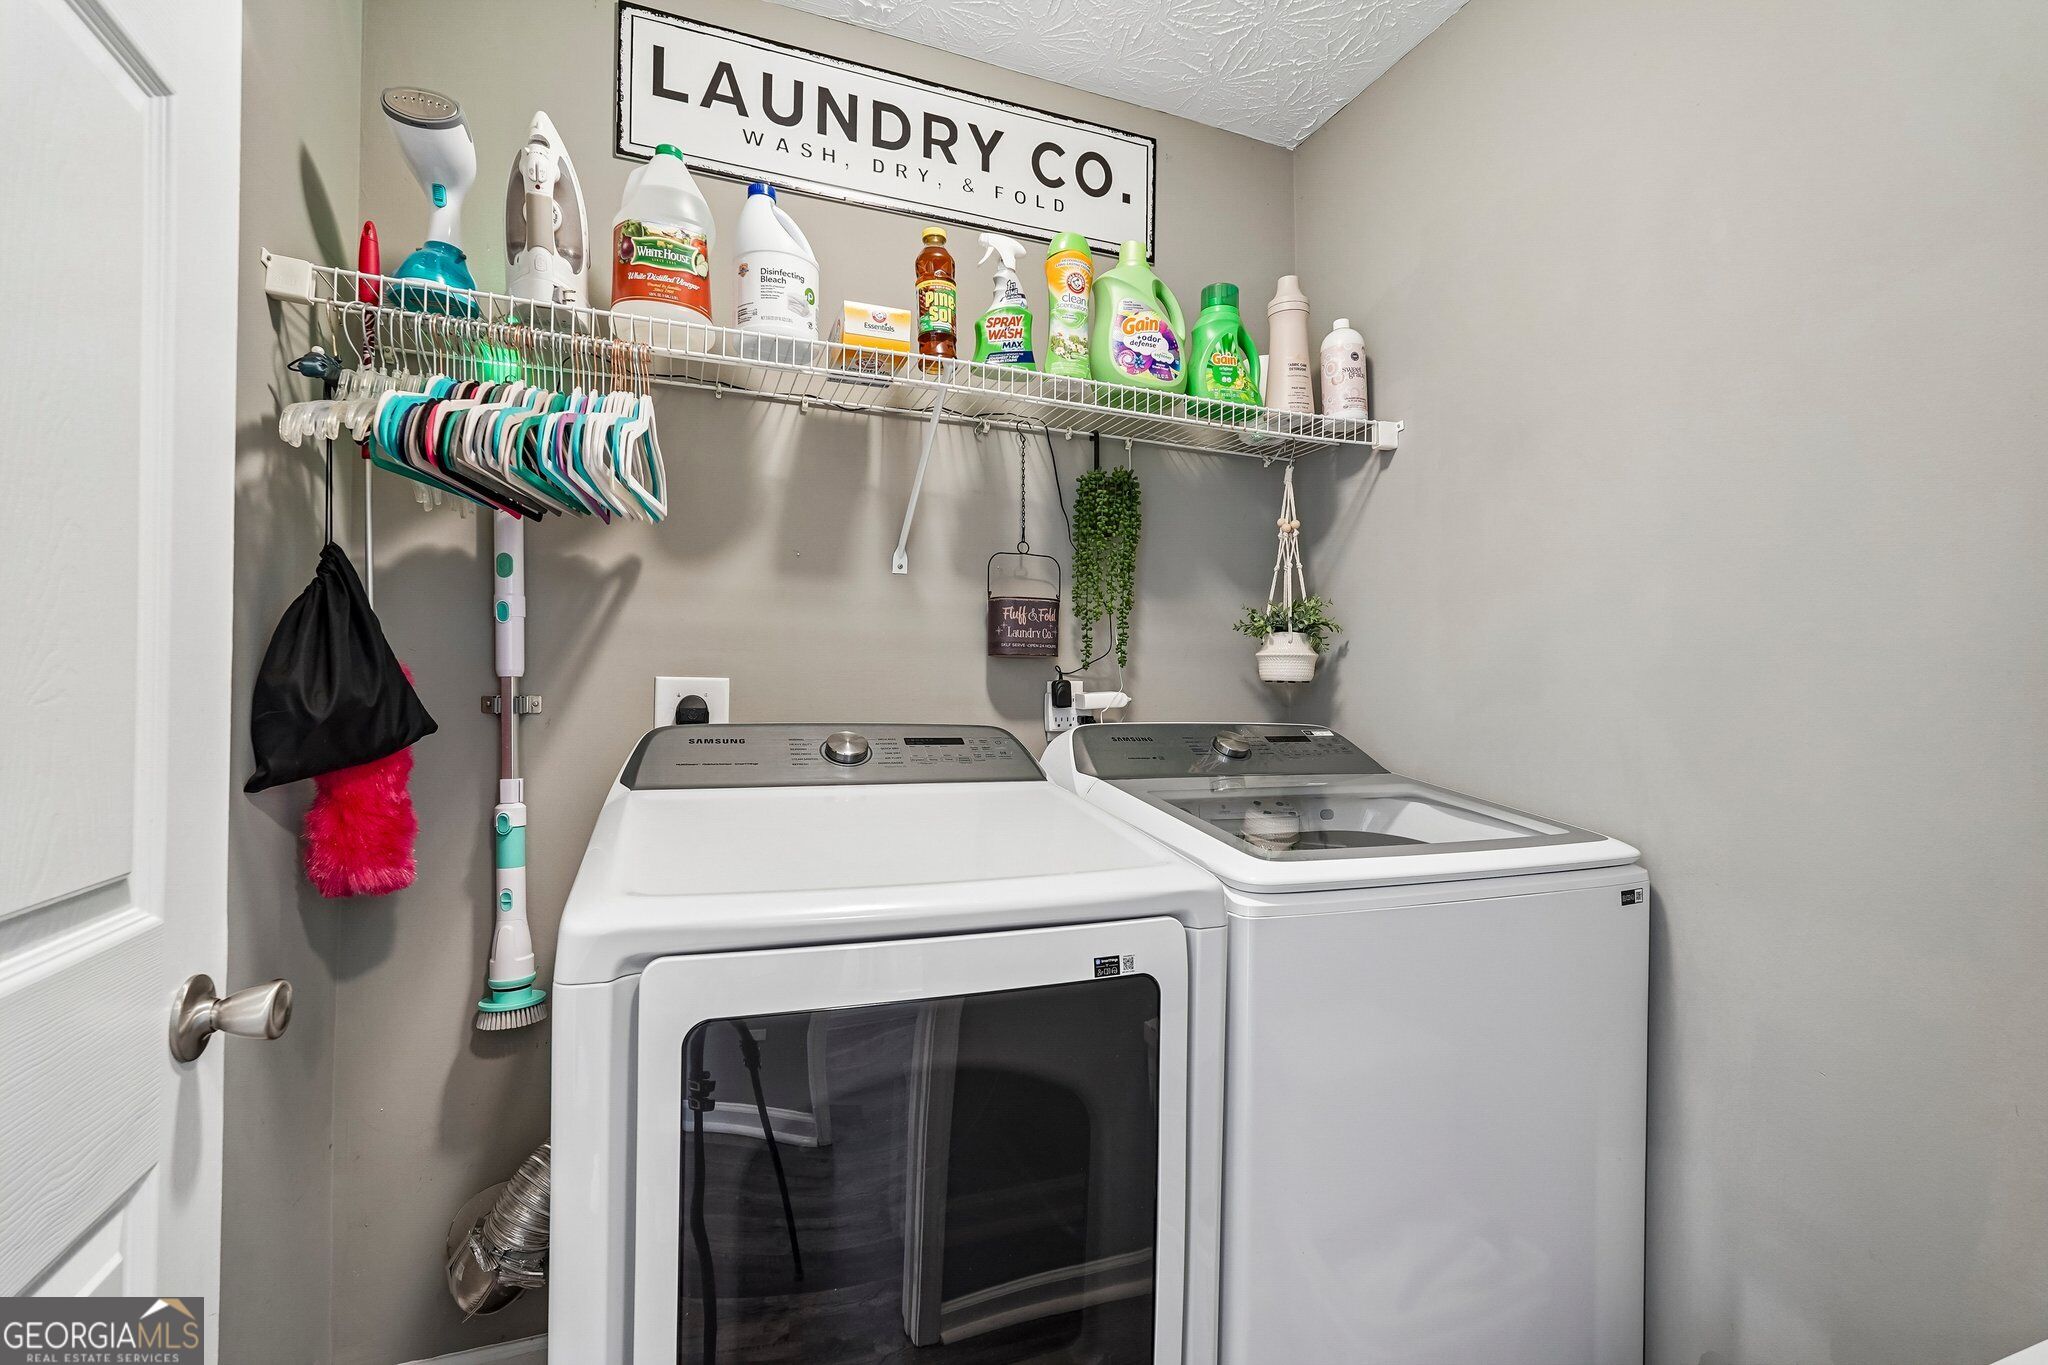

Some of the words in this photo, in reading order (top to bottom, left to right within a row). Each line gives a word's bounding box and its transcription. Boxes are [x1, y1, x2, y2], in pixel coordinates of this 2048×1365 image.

[652, 44, 1004, 173] LAUNDRY
[1030, 142, 1131, 204] CO.
[742, 129, 850, 170] WASH,
[873, 158, 942, 190] DRY,
[962, 178, 975, 194] &
[995, 186, 1066, 213] FOLD
[628, 272, 646, 280] White
[647, 272, 675, 283] Distilled
[675, 277, 700, 290] Vinegar
[760, 268, 805, 284] Disinfecting
[760, 276, 786, 284] Bleach
[1062, 293, 1086, 306] clean
[864, 321, 895, 332] Essentials
[986, 316, 1023, 328] SPRAY
[1122, 317, 1159, 335] Gain
[988, 328, 1023, 340] WASH
[1002, 341, 1023, 349] MAX
[1130, 340, 1156, 348] defense
[1212, 352, 1237, 366] Gain
[1002, 605, 1027, 625] Fluff
[1038, 607, 1056, 621] Fold
[1007, 626, 1041, 638] Laundry
